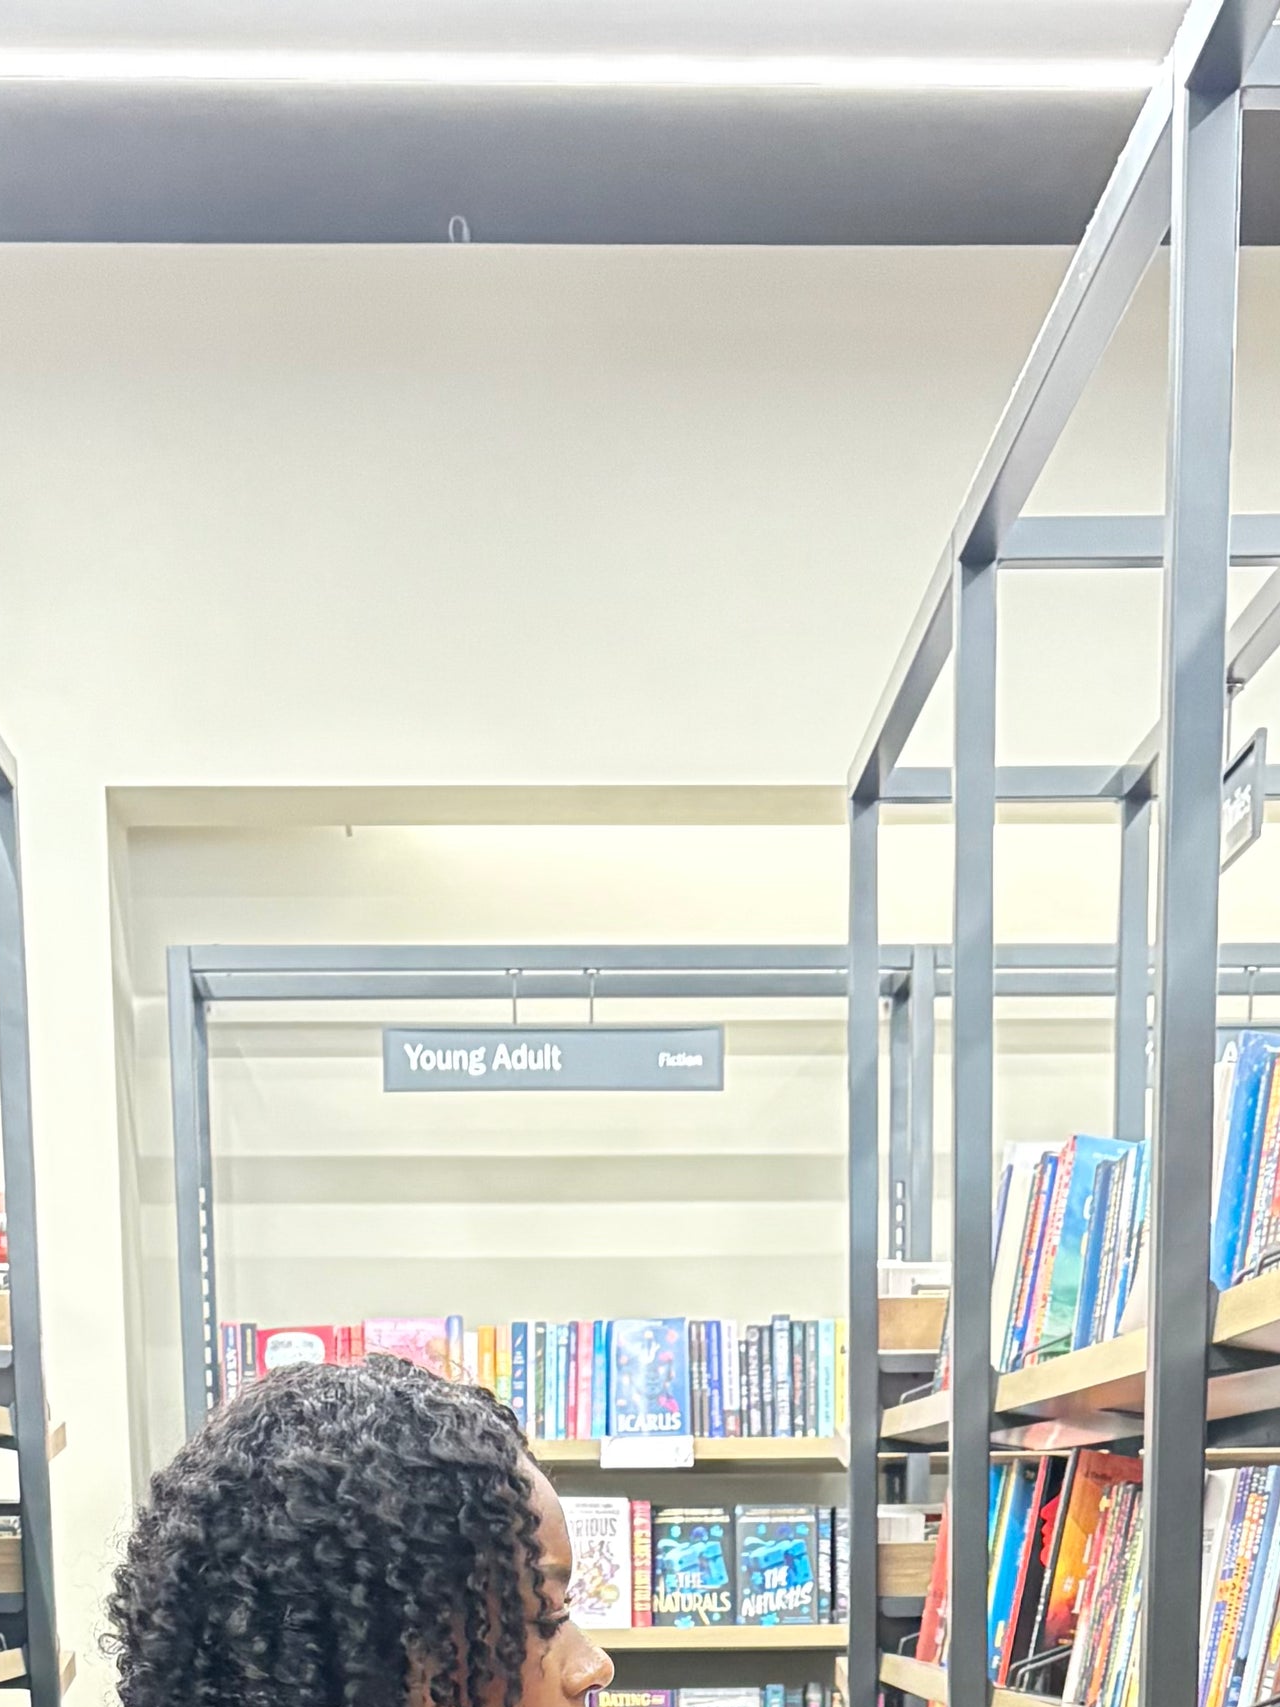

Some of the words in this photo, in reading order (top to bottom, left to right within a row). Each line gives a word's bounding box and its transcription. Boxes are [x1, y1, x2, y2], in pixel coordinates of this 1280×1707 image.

[403, 1042, 486, 1076] Young
[492, 1042, 562, 1071] Adult
[658, 1051, 703, 1068] Fiction
[617, 1411, 682, 1432] ICARUS
[652, 1590, 731, 1614] NATURALS
[599, 1691, 650, 1707] DATING
